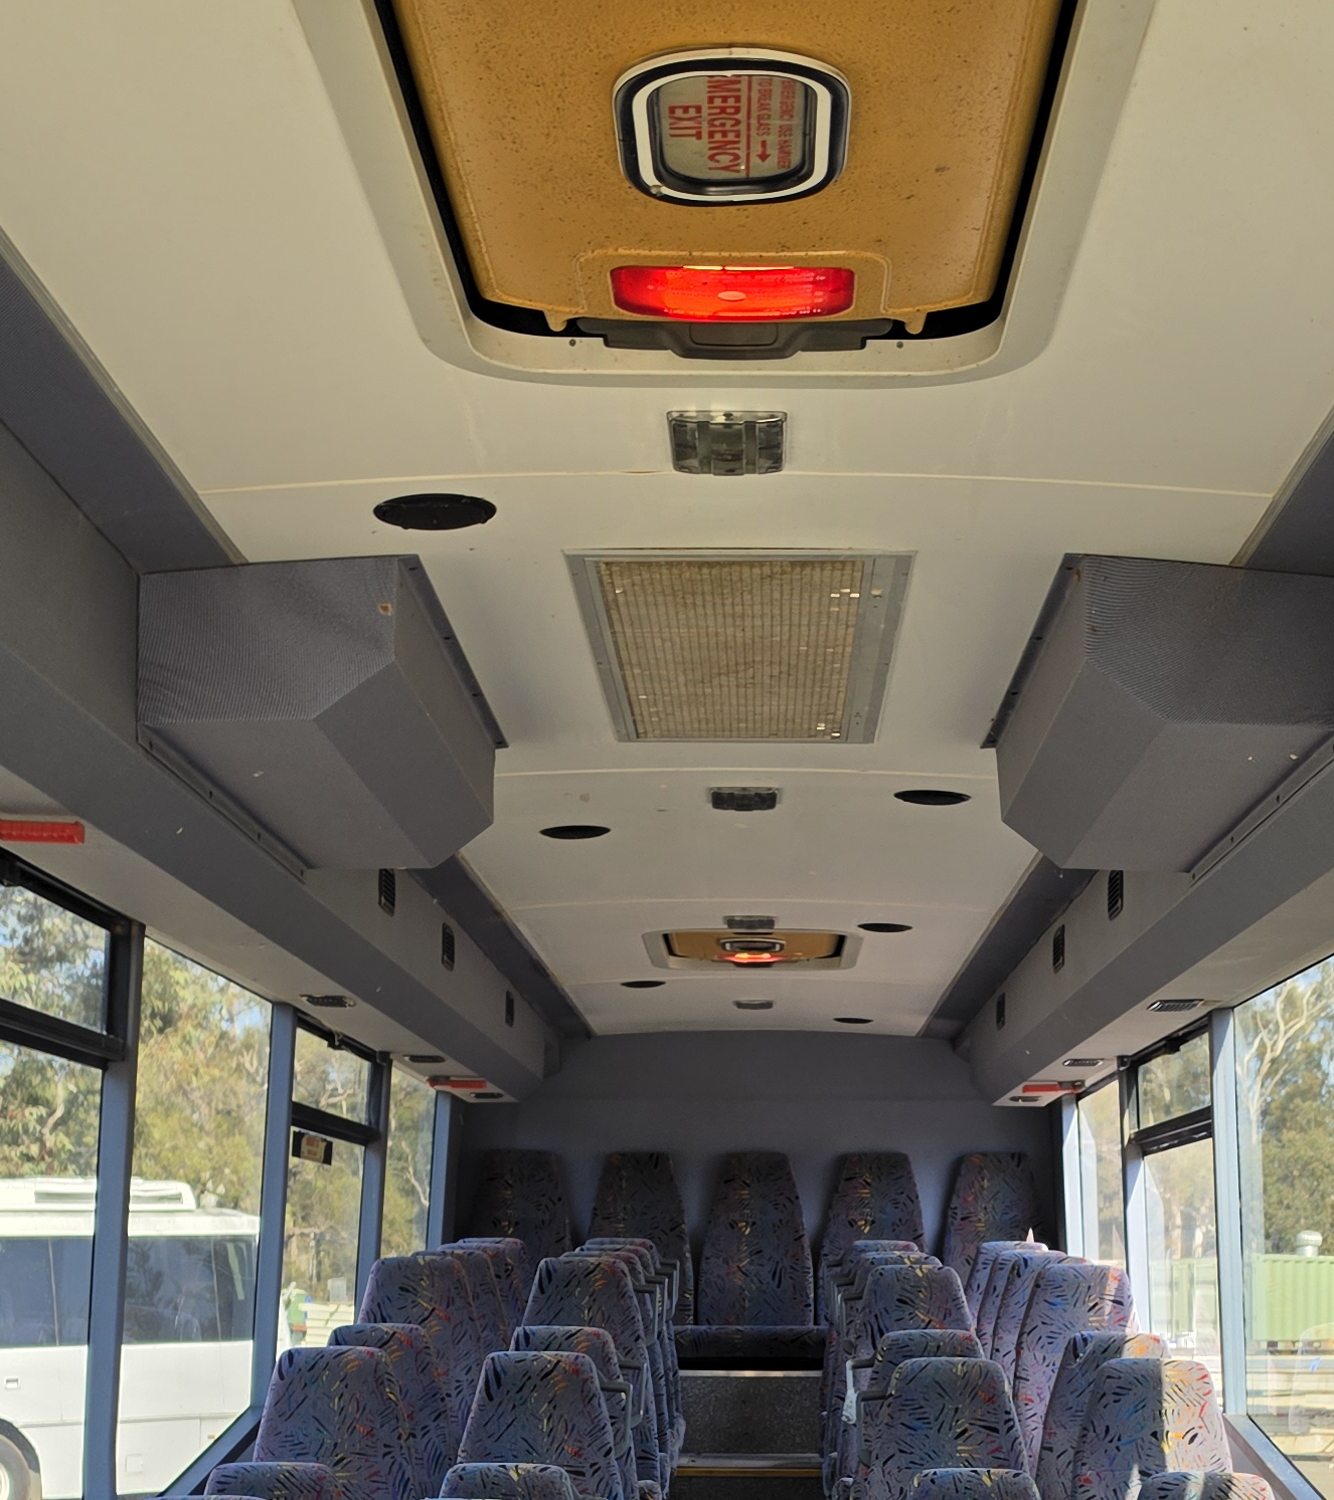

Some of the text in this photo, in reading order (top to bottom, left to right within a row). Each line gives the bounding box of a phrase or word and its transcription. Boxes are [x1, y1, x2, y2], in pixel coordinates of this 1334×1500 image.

[757, 88, 772, 111] BREAK
[668, 104, 703, 140] EXIT
[756, 112, 771, 136] GLASS
